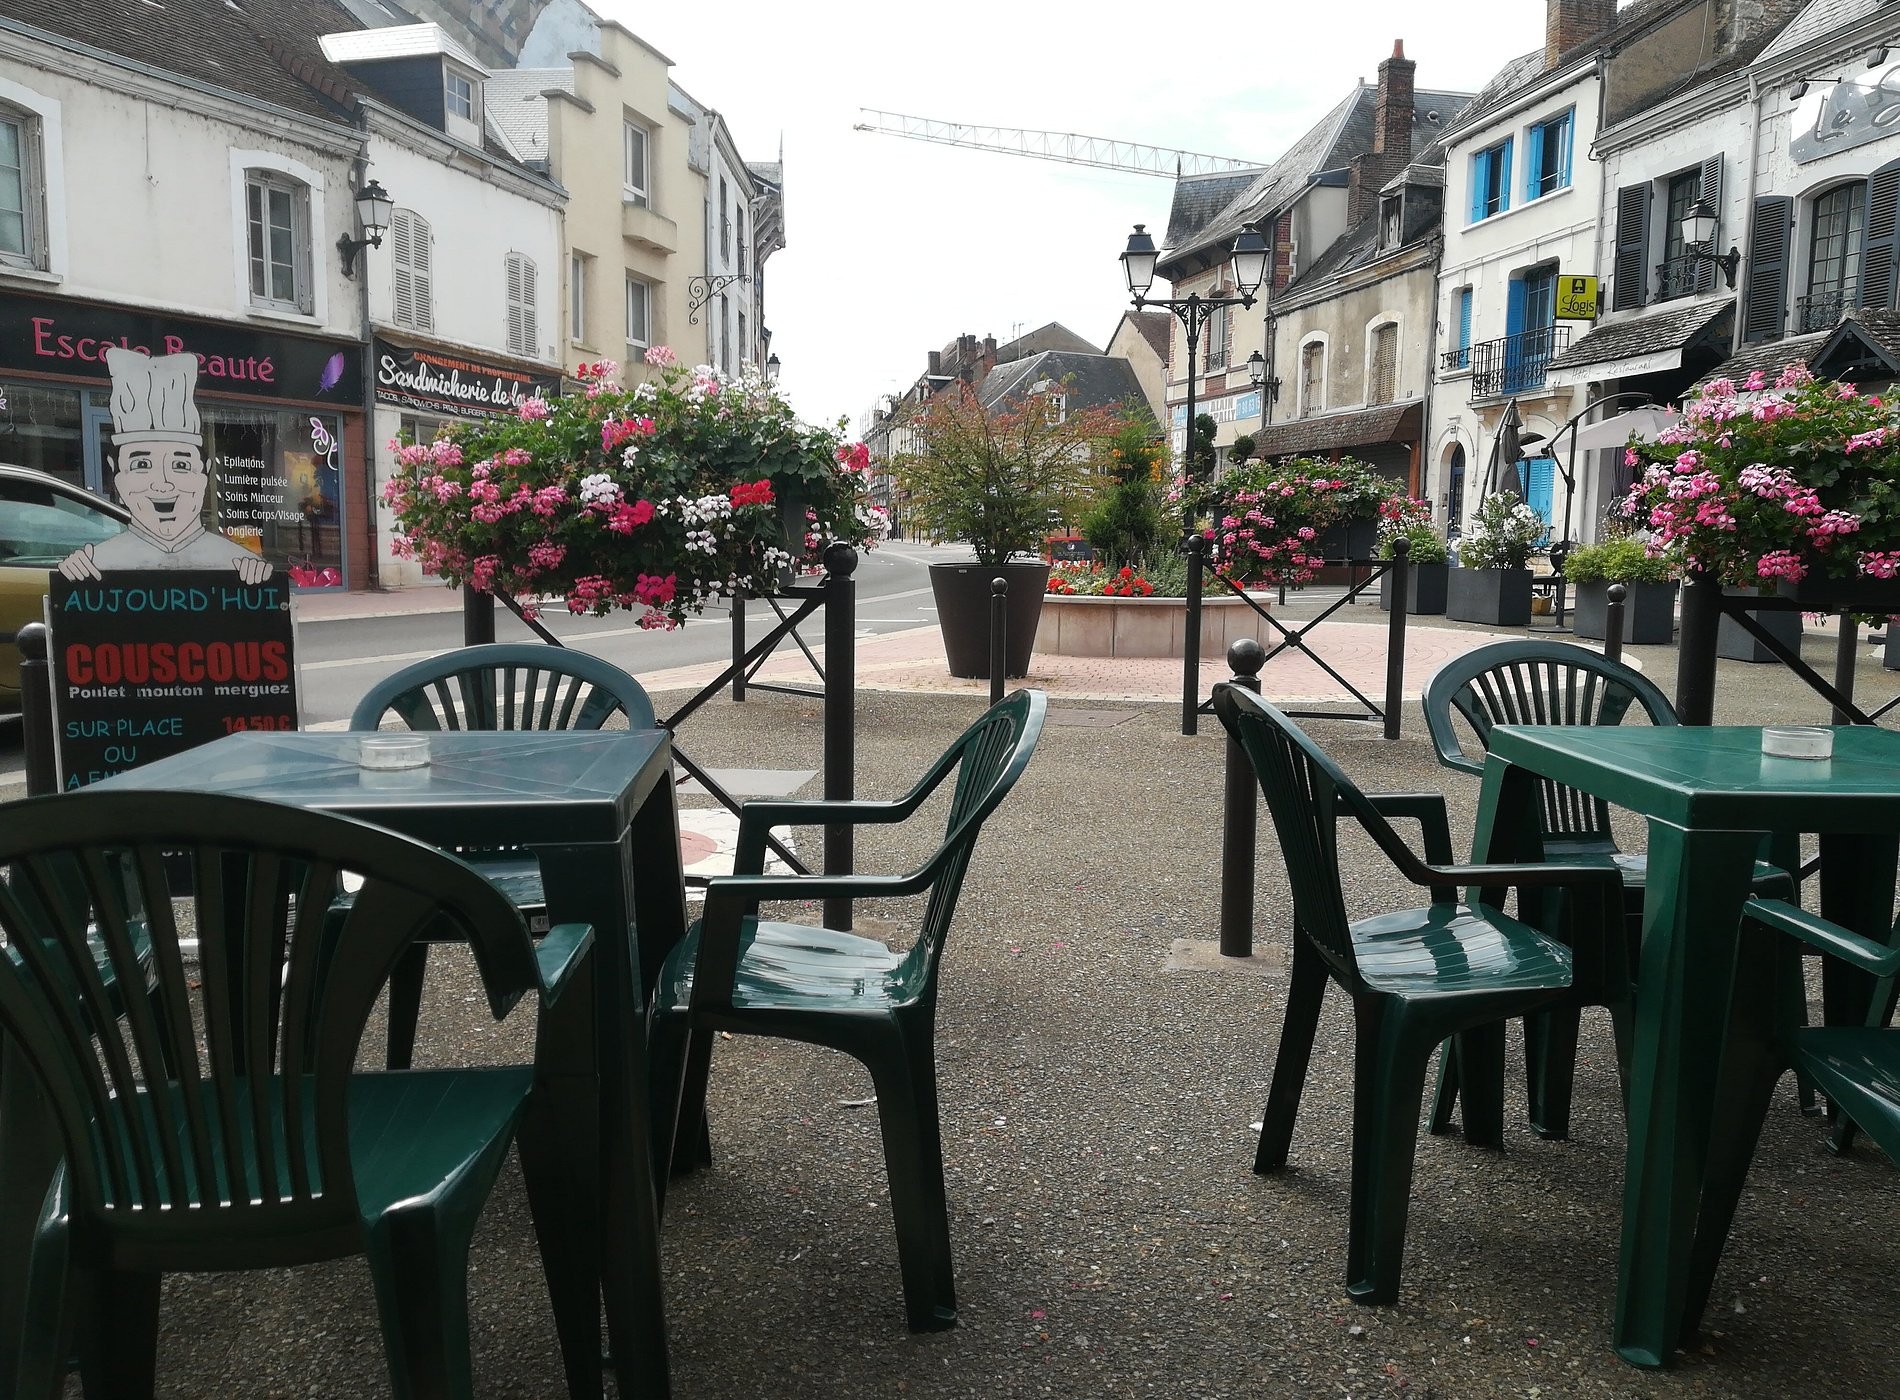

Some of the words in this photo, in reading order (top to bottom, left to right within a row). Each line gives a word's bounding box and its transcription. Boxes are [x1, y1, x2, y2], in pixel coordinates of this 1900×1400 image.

[1560, 294, 1594, 316] Logis
[413, 352, 470, 370] CHANGEMENT
[471, 364, 481, 373] DE
[1607, 357, 1653, 376] Restaurant
[378, 354, 489, 402] Sandwicherie
[491, 378, 509, 405] de
[376, 390, 398, 402] TACOS
[461, 407, 487, 418] BURGERS
[224, 456, 265, 469] Epilations
[224, 473, 259, 485] Lumière
[260, 475, 288, 488] pulsée
[225, 491, 248, 502] Soins
[250, 492, 284, 503] Minceur
[226, 508, 249, 519] Soins
[251, 509, 305, 522] Corps/Visage
[227, 525, 264, 538] Onglerie
[64, 587, 279, 612] AUJOURD'HUI
[66, 640, 288, 685] COUSCOUS
[69, 686, 126, 699] Poulet
[137, 684, 203, 698] mouton
[214, 684, 290, 698] merguez
[66, 720, 111, 738] SUR
[117, 717, 183, 737] PLACE
[104, 746, 136, 764] OU
